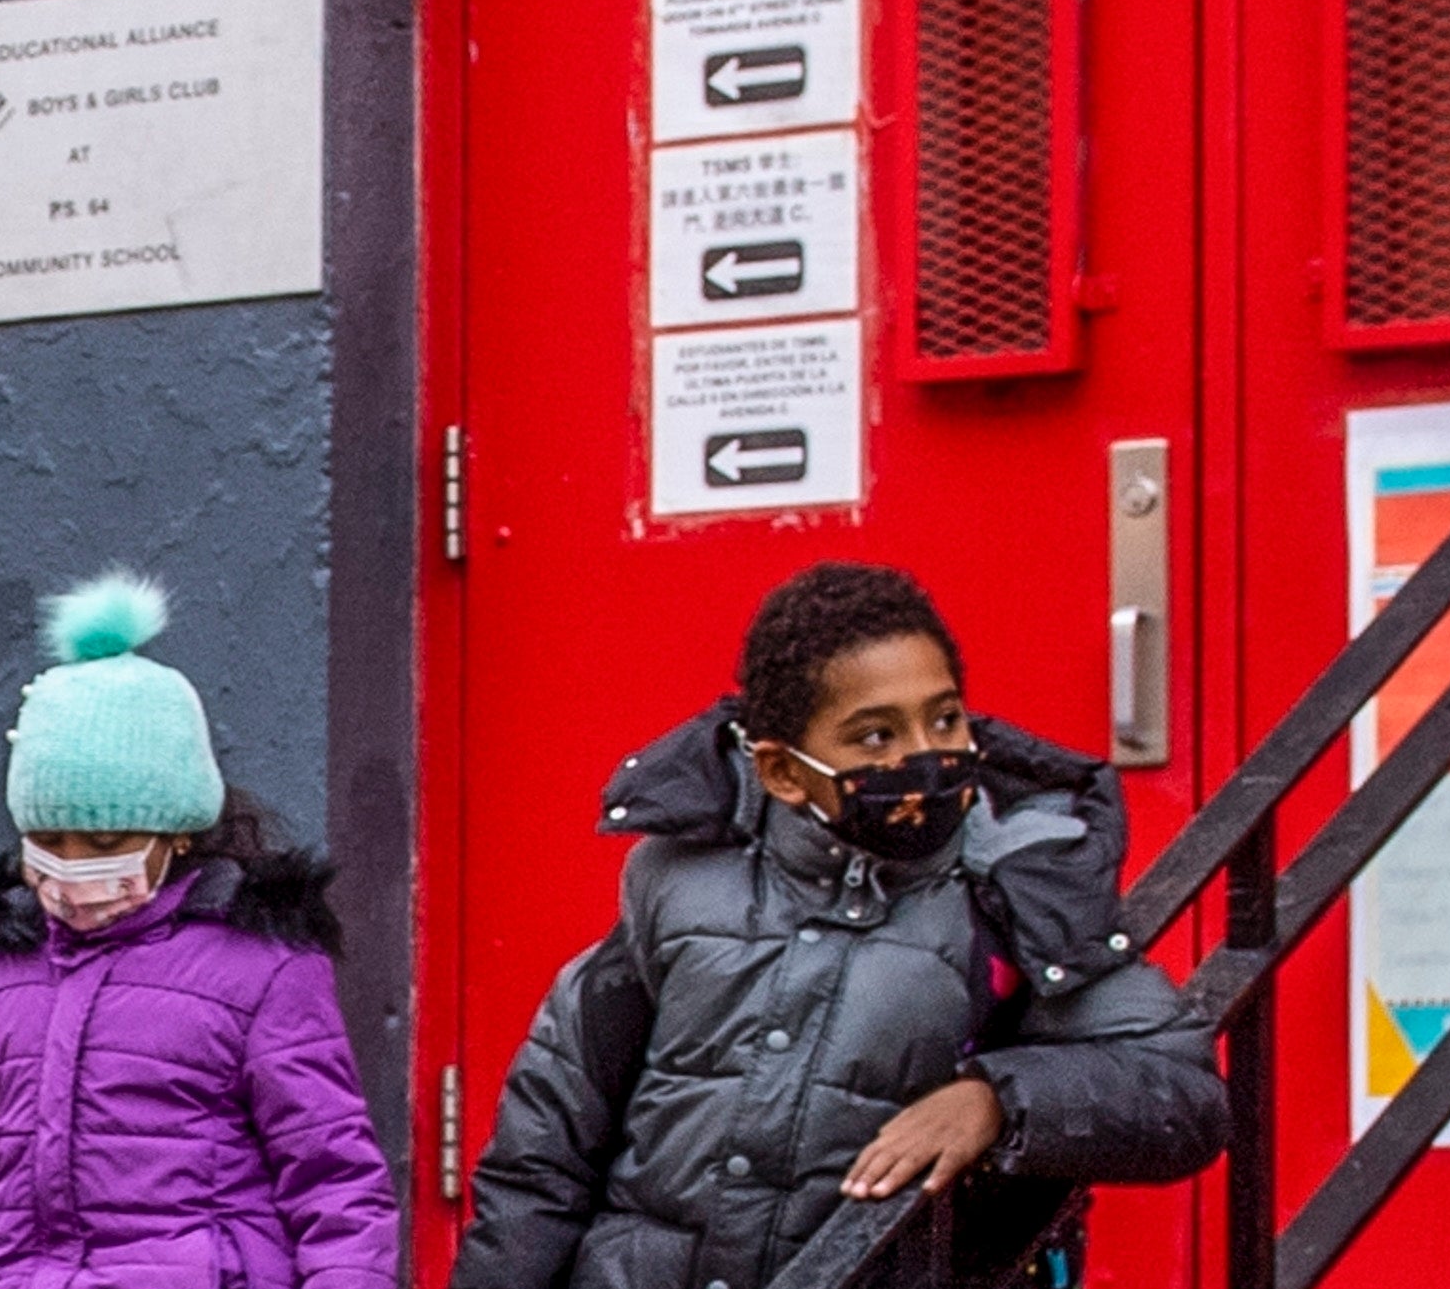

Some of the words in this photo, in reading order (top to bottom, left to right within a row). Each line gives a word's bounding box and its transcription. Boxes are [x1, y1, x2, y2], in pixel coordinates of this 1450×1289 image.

[126, 18, 220, 47] ALLIANCE
[27, 93, 79, 117] BOYS
[86, 92, 98, 109] &
[105, 85, 162, 109] GIRLS
[169, 77, 221, 101] CLUB
[67, 146, 90, 165] AT
[701, 156, 751, 176] TSMS
[88, 198, 110, 215] 64
[101, 243, 181, 270] SCHOOL
